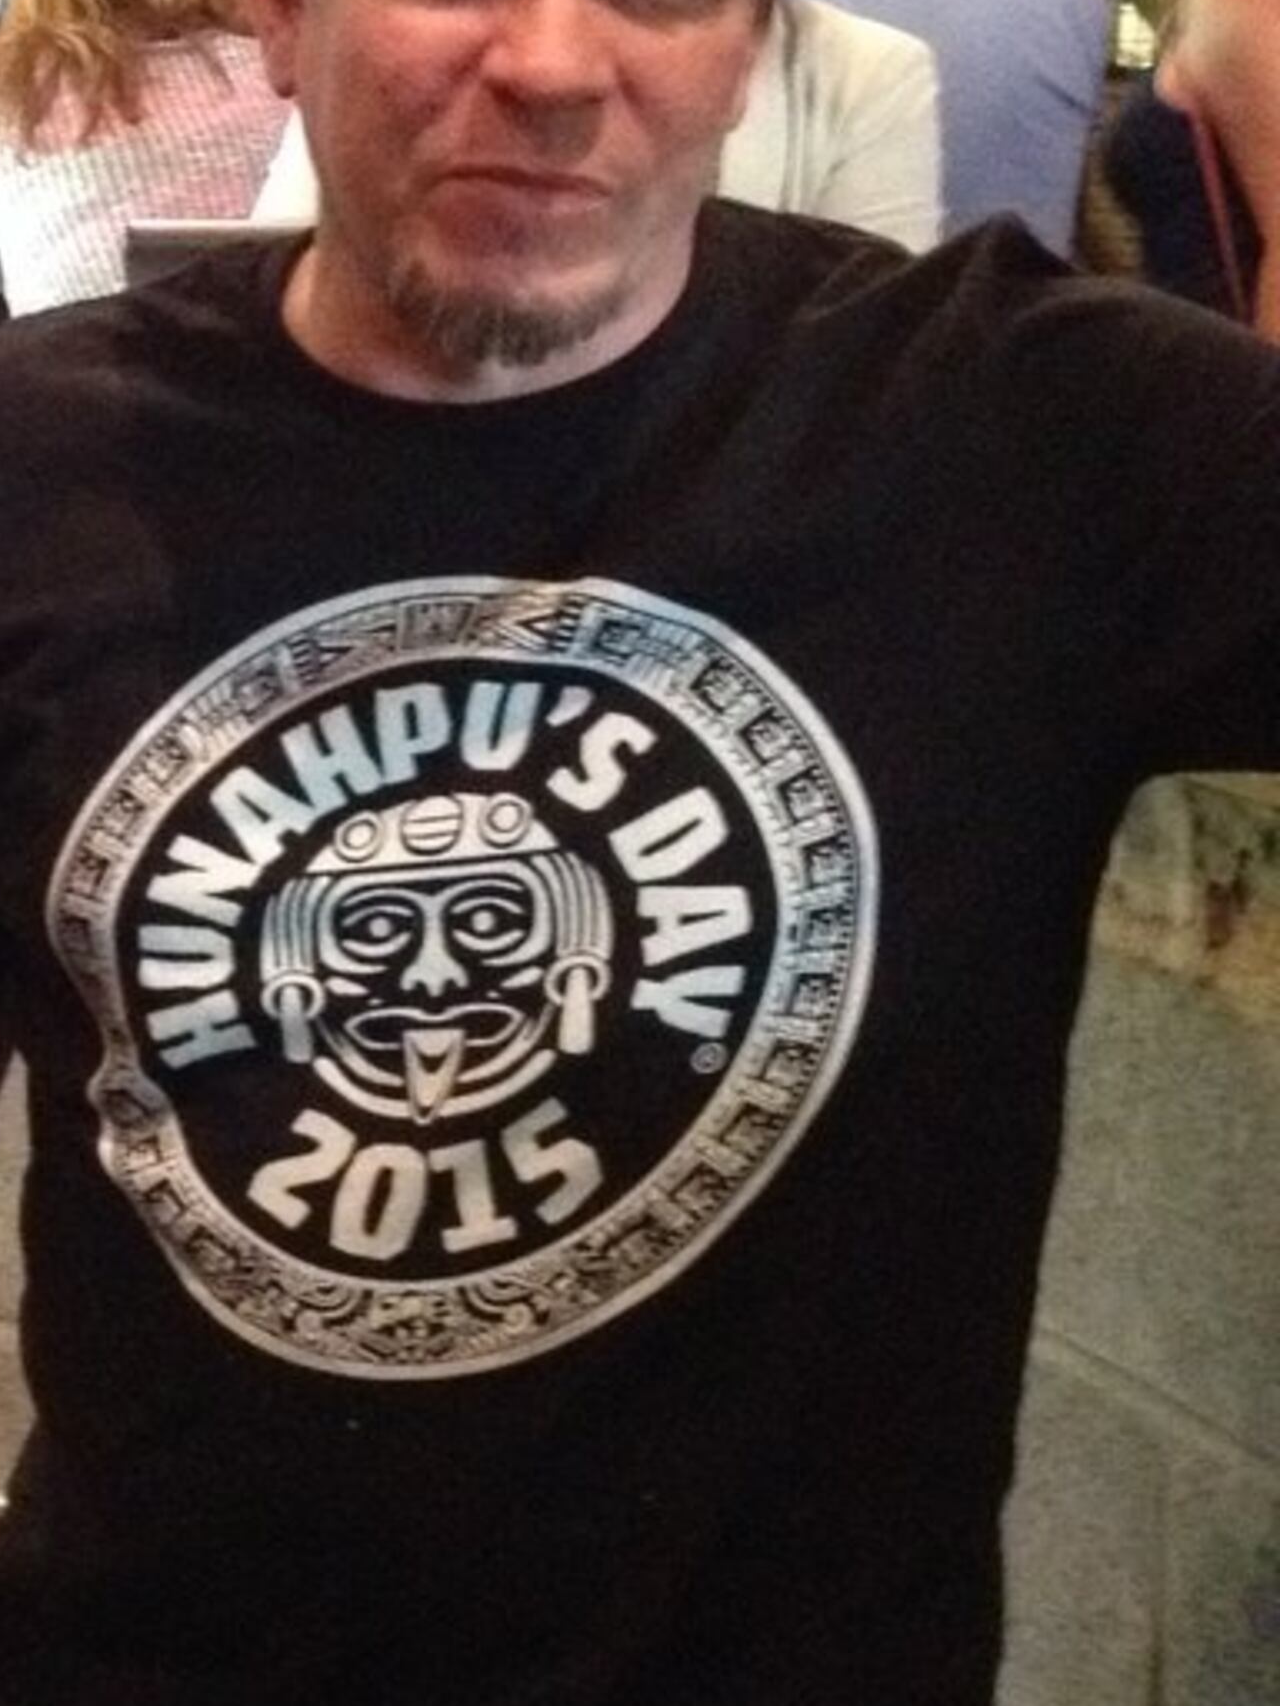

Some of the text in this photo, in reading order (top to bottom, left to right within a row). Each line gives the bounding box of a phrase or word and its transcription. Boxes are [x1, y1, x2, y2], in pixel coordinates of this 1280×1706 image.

[137, 681, 753, 1070] HUNAHPU'S DAY
[248, 1097, 604, 1261] 2015
